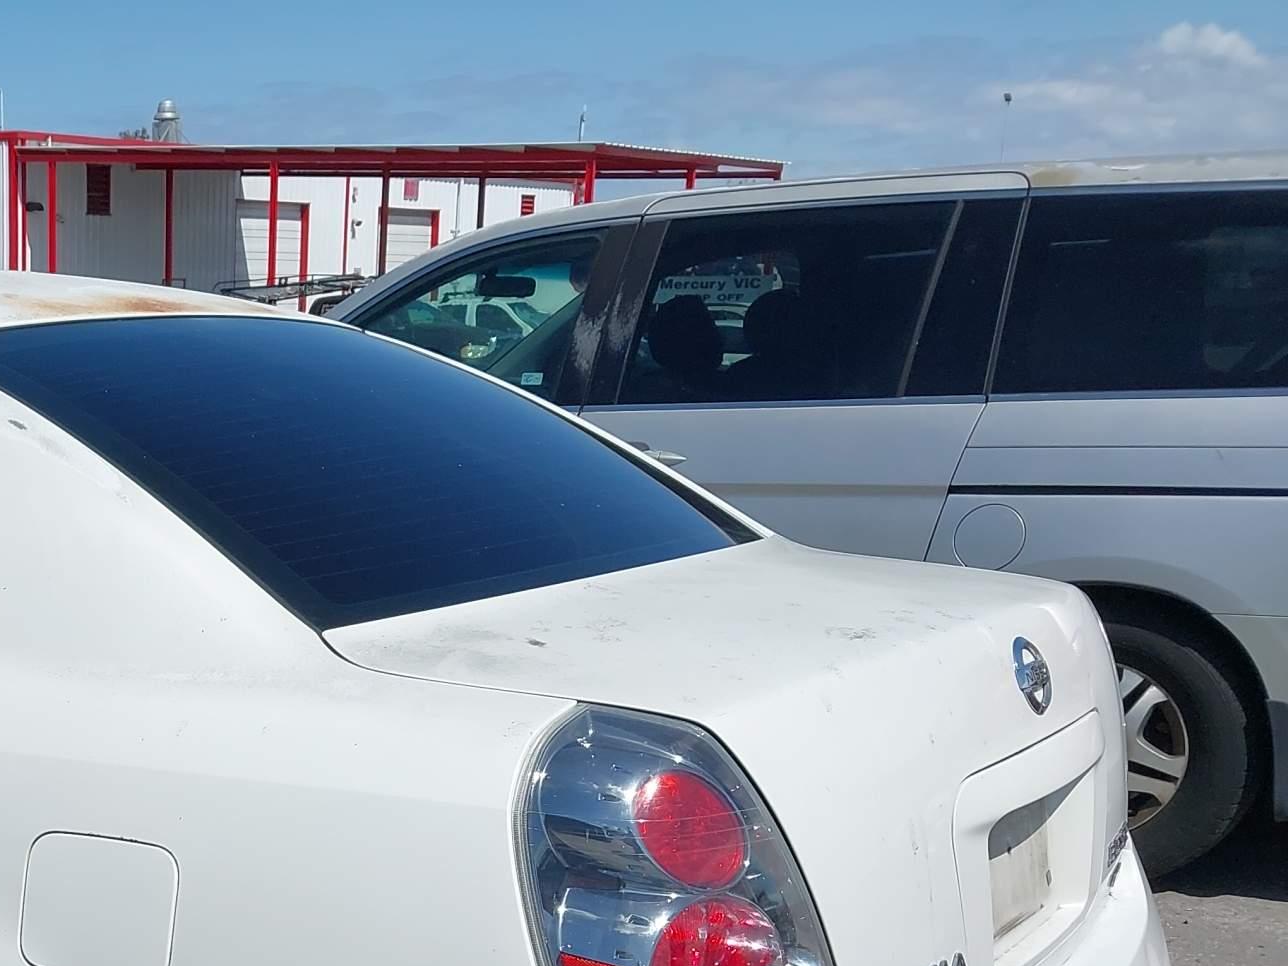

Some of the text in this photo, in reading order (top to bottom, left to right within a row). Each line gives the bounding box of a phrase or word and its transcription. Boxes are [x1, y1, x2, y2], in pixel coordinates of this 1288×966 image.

[660, 277, 761, 291] Mercury VIC
[717, 293, 744, 302] OFF
